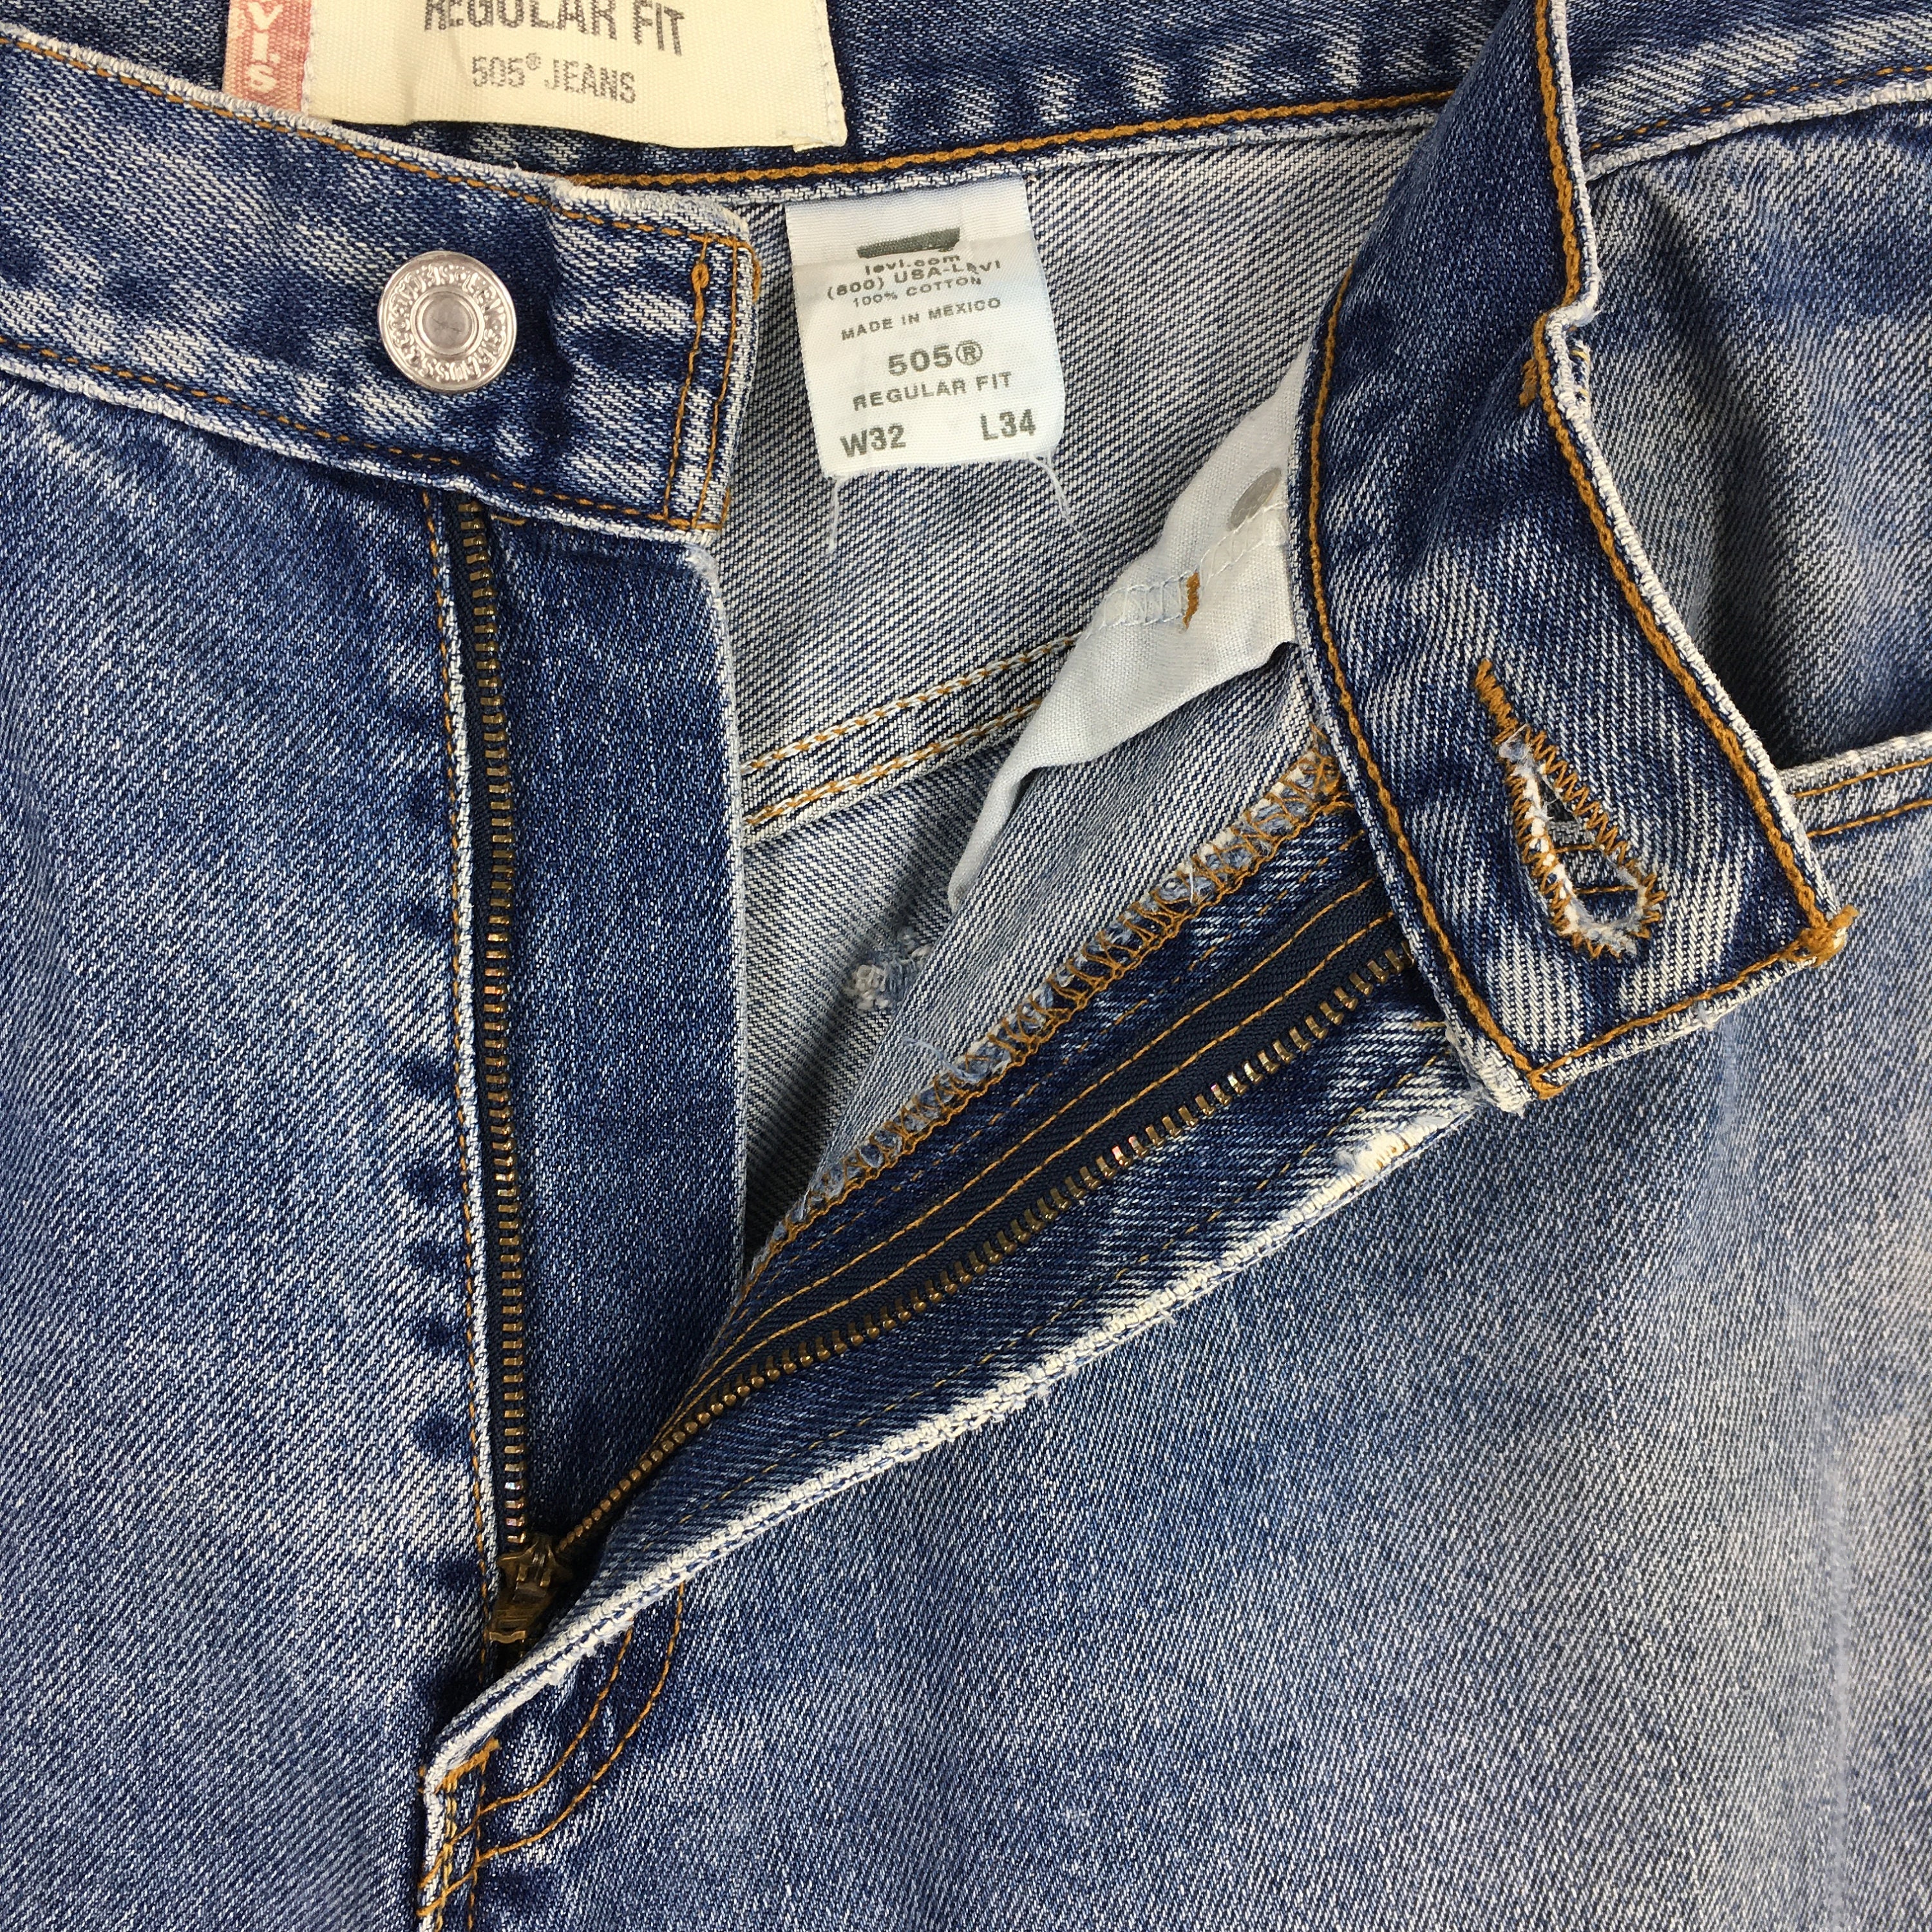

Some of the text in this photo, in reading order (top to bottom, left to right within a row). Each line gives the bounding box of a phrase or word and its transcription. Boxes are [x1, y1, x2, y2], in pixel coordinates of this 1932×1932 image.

[633, 0, 685, 57] FIT
[544, 59, 636, 104] JEANS
[827, 276, 885, 300] (800)
[853, 276, 982, 308] 100% COTTON
[840, 297, 1001, 340] MADE IN MEXICO
[887, 339, 983, 377] 505®
[852, 371, 1012, 412] REGULAR FIT
[839, 422, 907, 458] W32
[980, 408, 1037, 441] L34
